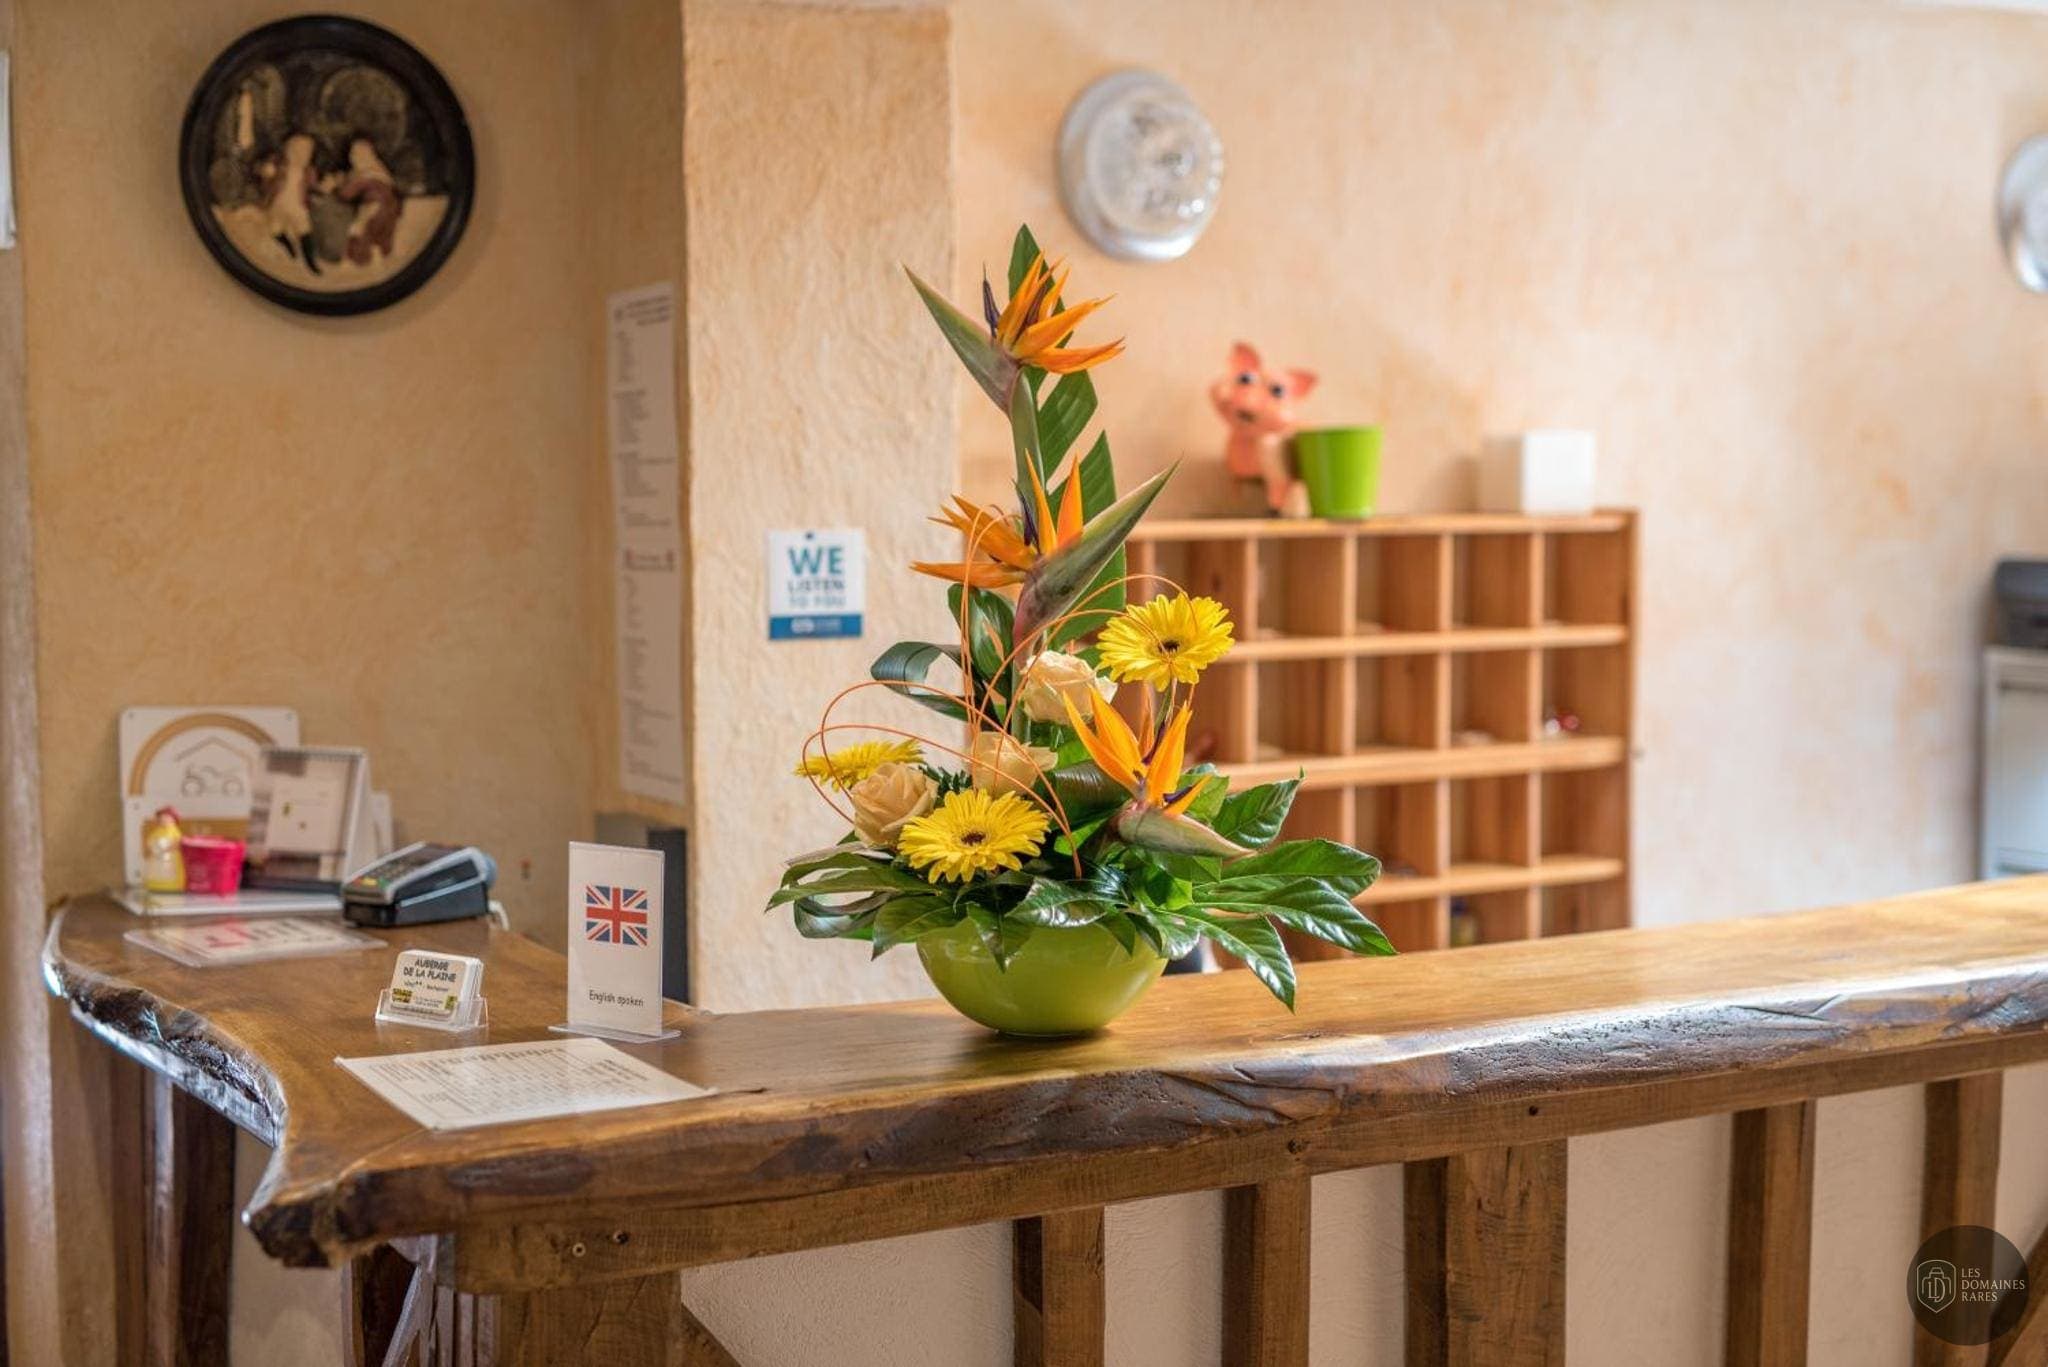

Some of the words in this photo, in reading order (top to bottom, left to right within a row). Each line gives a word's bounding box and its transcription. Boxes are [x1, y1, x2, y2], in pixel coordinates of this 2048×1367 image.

[787, 546, 844, 575] WE
[787, 579, 845, 594] LISTEN
[414, 959, 449, 971] AUBERGE
[403, 967, 414, 977] DE
[416, 969, 425, 978] LA
[428, 970, 457, 982] PLAINE
[589, 989, 615, 1005] English
[617, 995, 644, 1007] spoken
